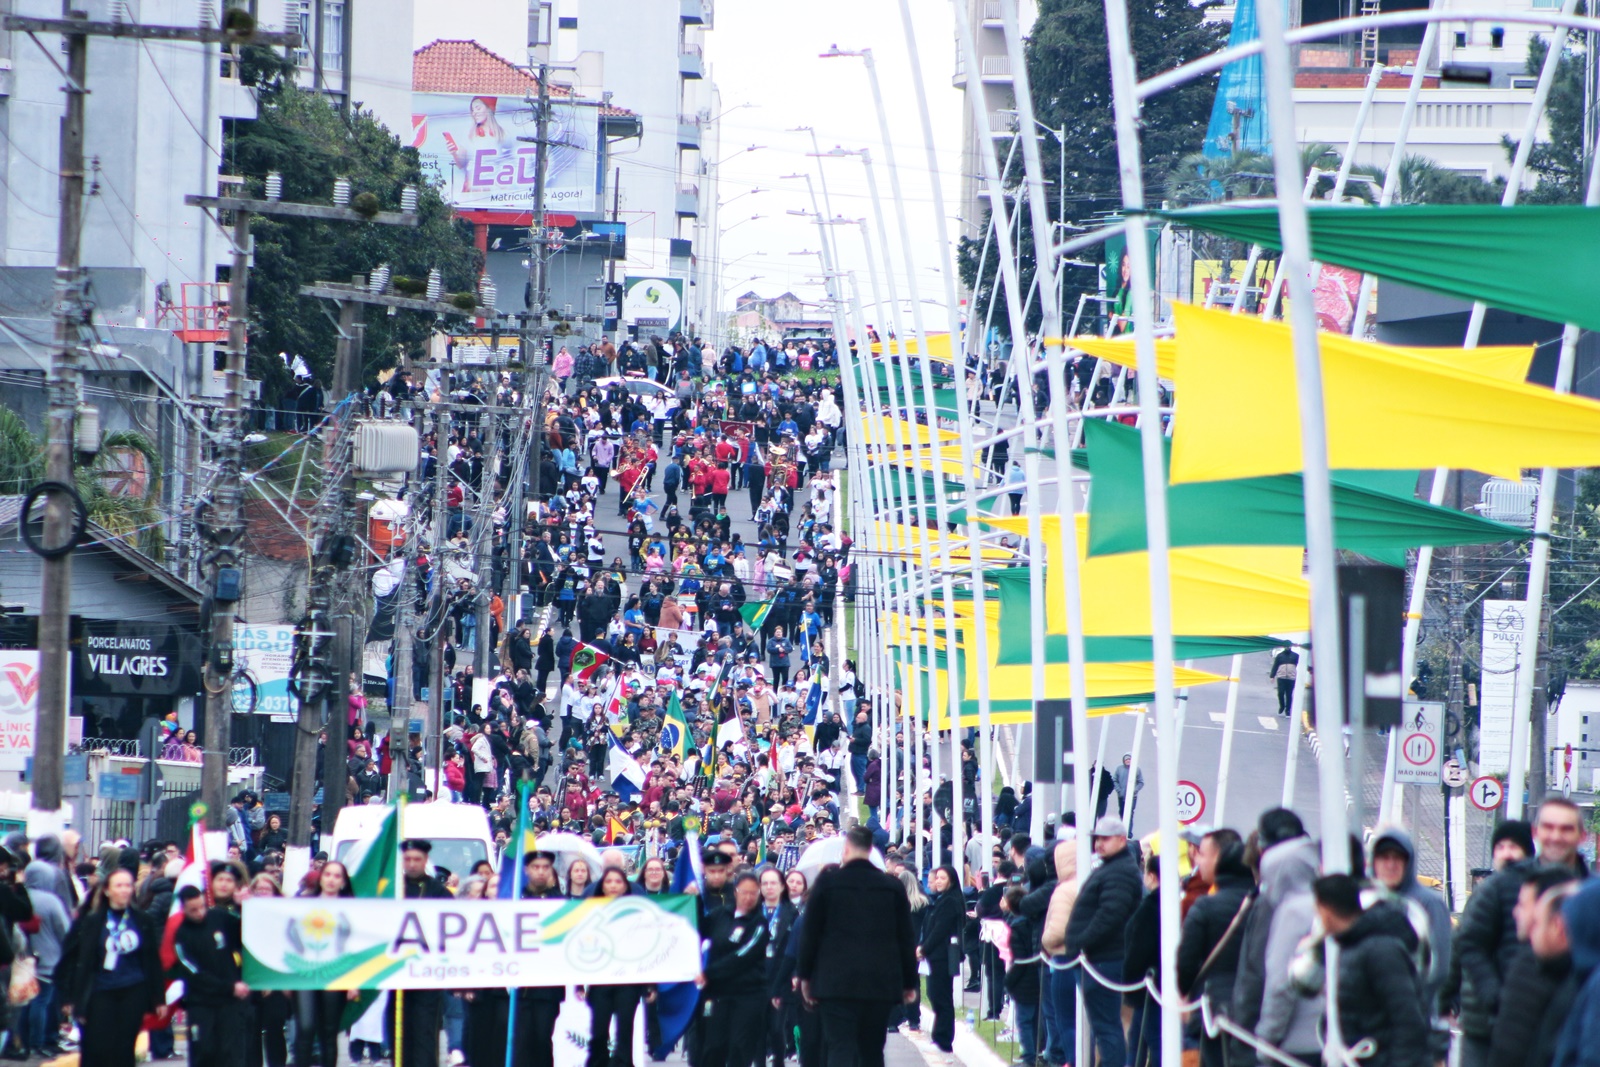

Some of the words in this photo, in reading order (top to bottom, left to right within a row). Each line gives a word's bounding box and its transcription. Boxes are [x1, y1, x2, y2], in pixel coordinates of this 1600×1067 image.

[551, 189, 583, 201] Agora!
[87, 636, 151, 651] PORCELANATOS
[1493, 632, 1524, 642] PULSA
[87, 653, 168, 677] VILLAGRES
[1415, 769, 1438, 778] ÚNICA
[392, 911, 541, 954] APAE
[408, 963, 471, 981] Lages
[491, 961, 520, 977] SC
